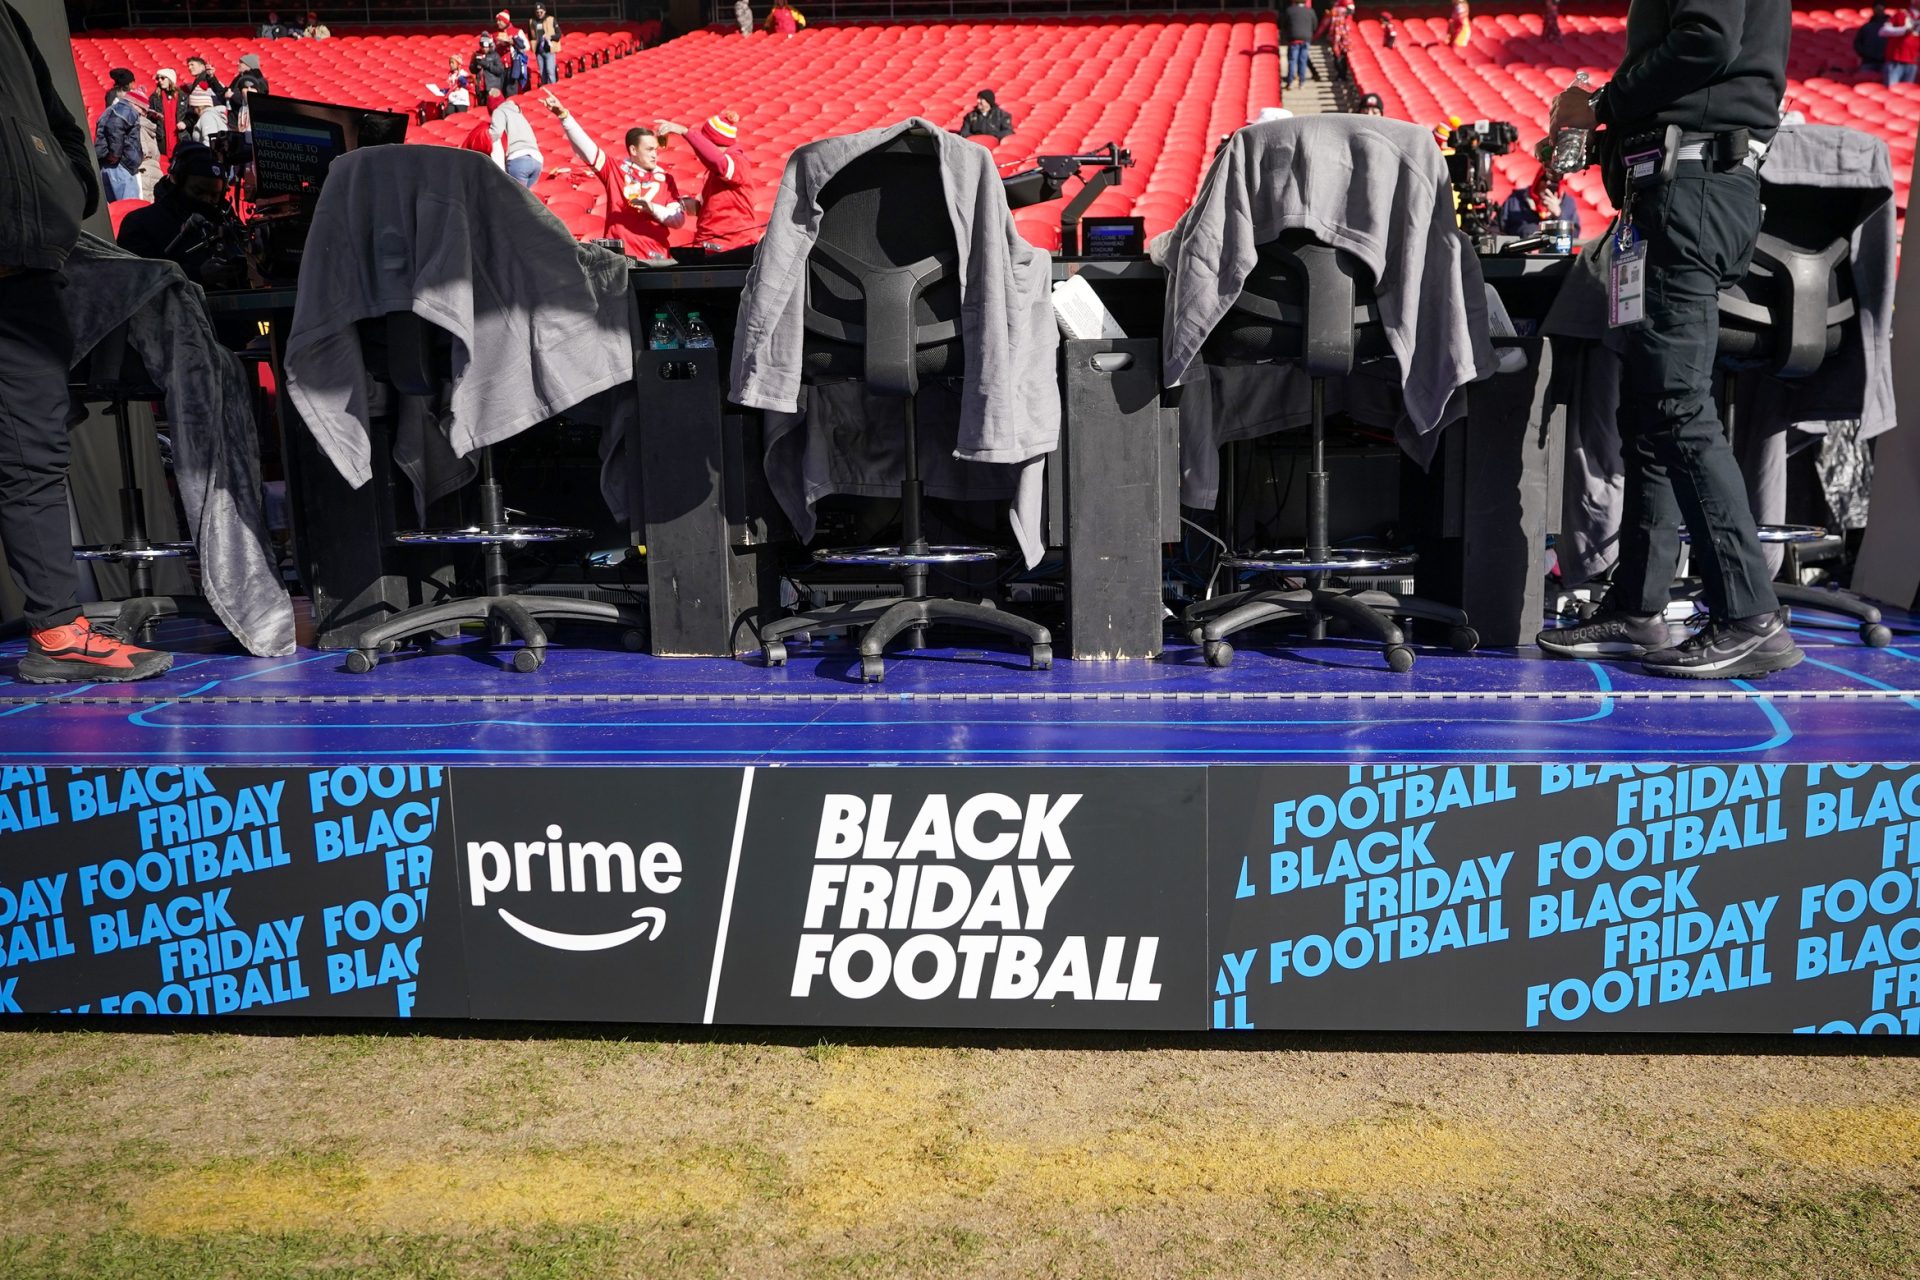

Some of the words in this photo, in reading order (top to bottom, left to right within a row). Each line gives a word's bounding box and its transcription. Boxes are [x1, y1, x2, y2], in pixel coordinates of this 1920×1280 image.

[256, 138, 304, 152] WELCOME
[305, 144, 318, 153] TO
[257, 149, 318, 164] ARROWHEAD
[261, 171, 296, 182] WHERE
[68, 765, 216, 822] BLACK
[139, 780, 286, 851] FRIDAY
[815, 793, 1084, 861] BLACK
[1274, 765, 1517, 846] FOOTBALL
[1617, 764, 1788, 826] FRIDAY
[315, 797, 440, 863] BLAC
[1271, 822, 1436, 895] BLACK
[1538, 799, 1788, 887] FOOTBALL
[79, 826, 291, 906] FOOTBALL
[467, 824, 683, 907] prime
[803, 865, 1075, 930] FRIDAY
[1345, 852, 1514, 926] FRIDAY
[90, 888, 237, 955] BLACK
[1529, 866, 1700, 939] BLACK
[1604, 896, 1780, 969] FRIDAY
[159, 916, 305, 983] FRIDAY
[791, 934, 1162, 1001] FOOTBALL
[1271, 900, 1510, 984] FOOTBALL
[1527, 944, 1772, 1028] FOOTBALL
